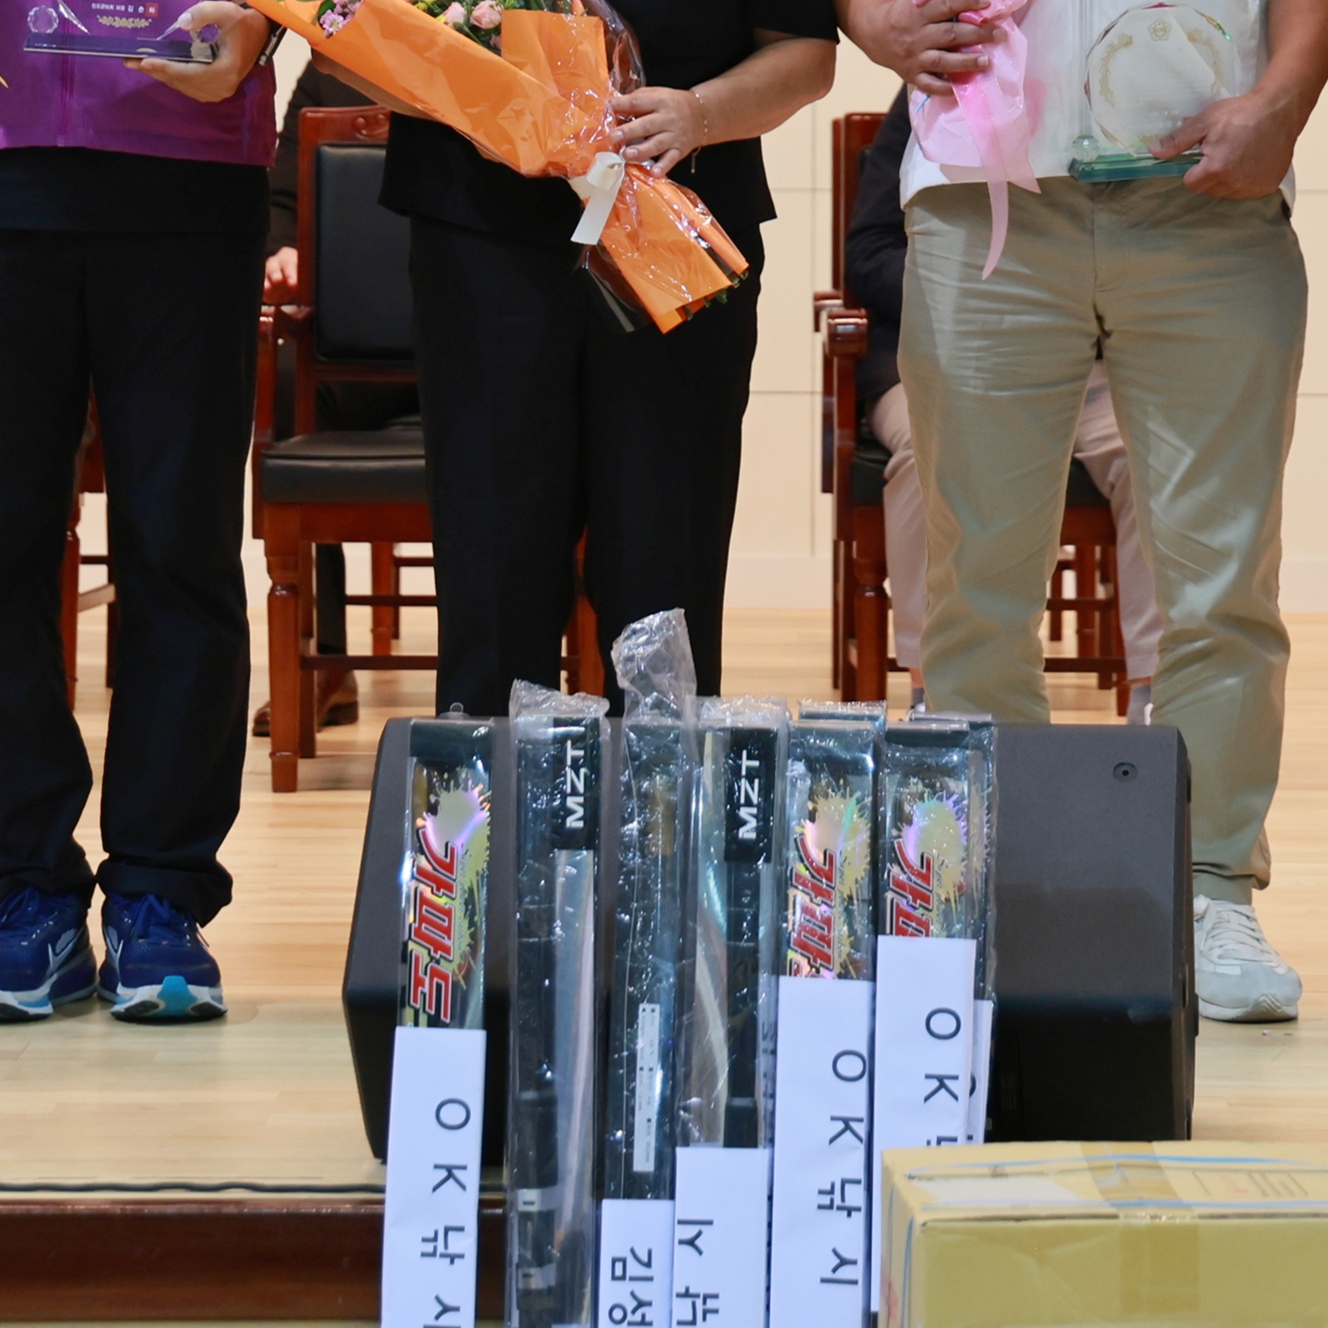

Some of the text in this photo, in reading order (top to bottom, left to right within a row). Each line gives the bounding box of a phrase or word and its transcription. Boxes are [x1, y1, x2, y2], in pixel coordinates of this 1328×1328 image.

[565, 739, 585, 829] MZT
[738, 749, 760, 840] MZT
[409, 826, 457, 1023] 가파도
[787, 835, 836, 977] 가파
